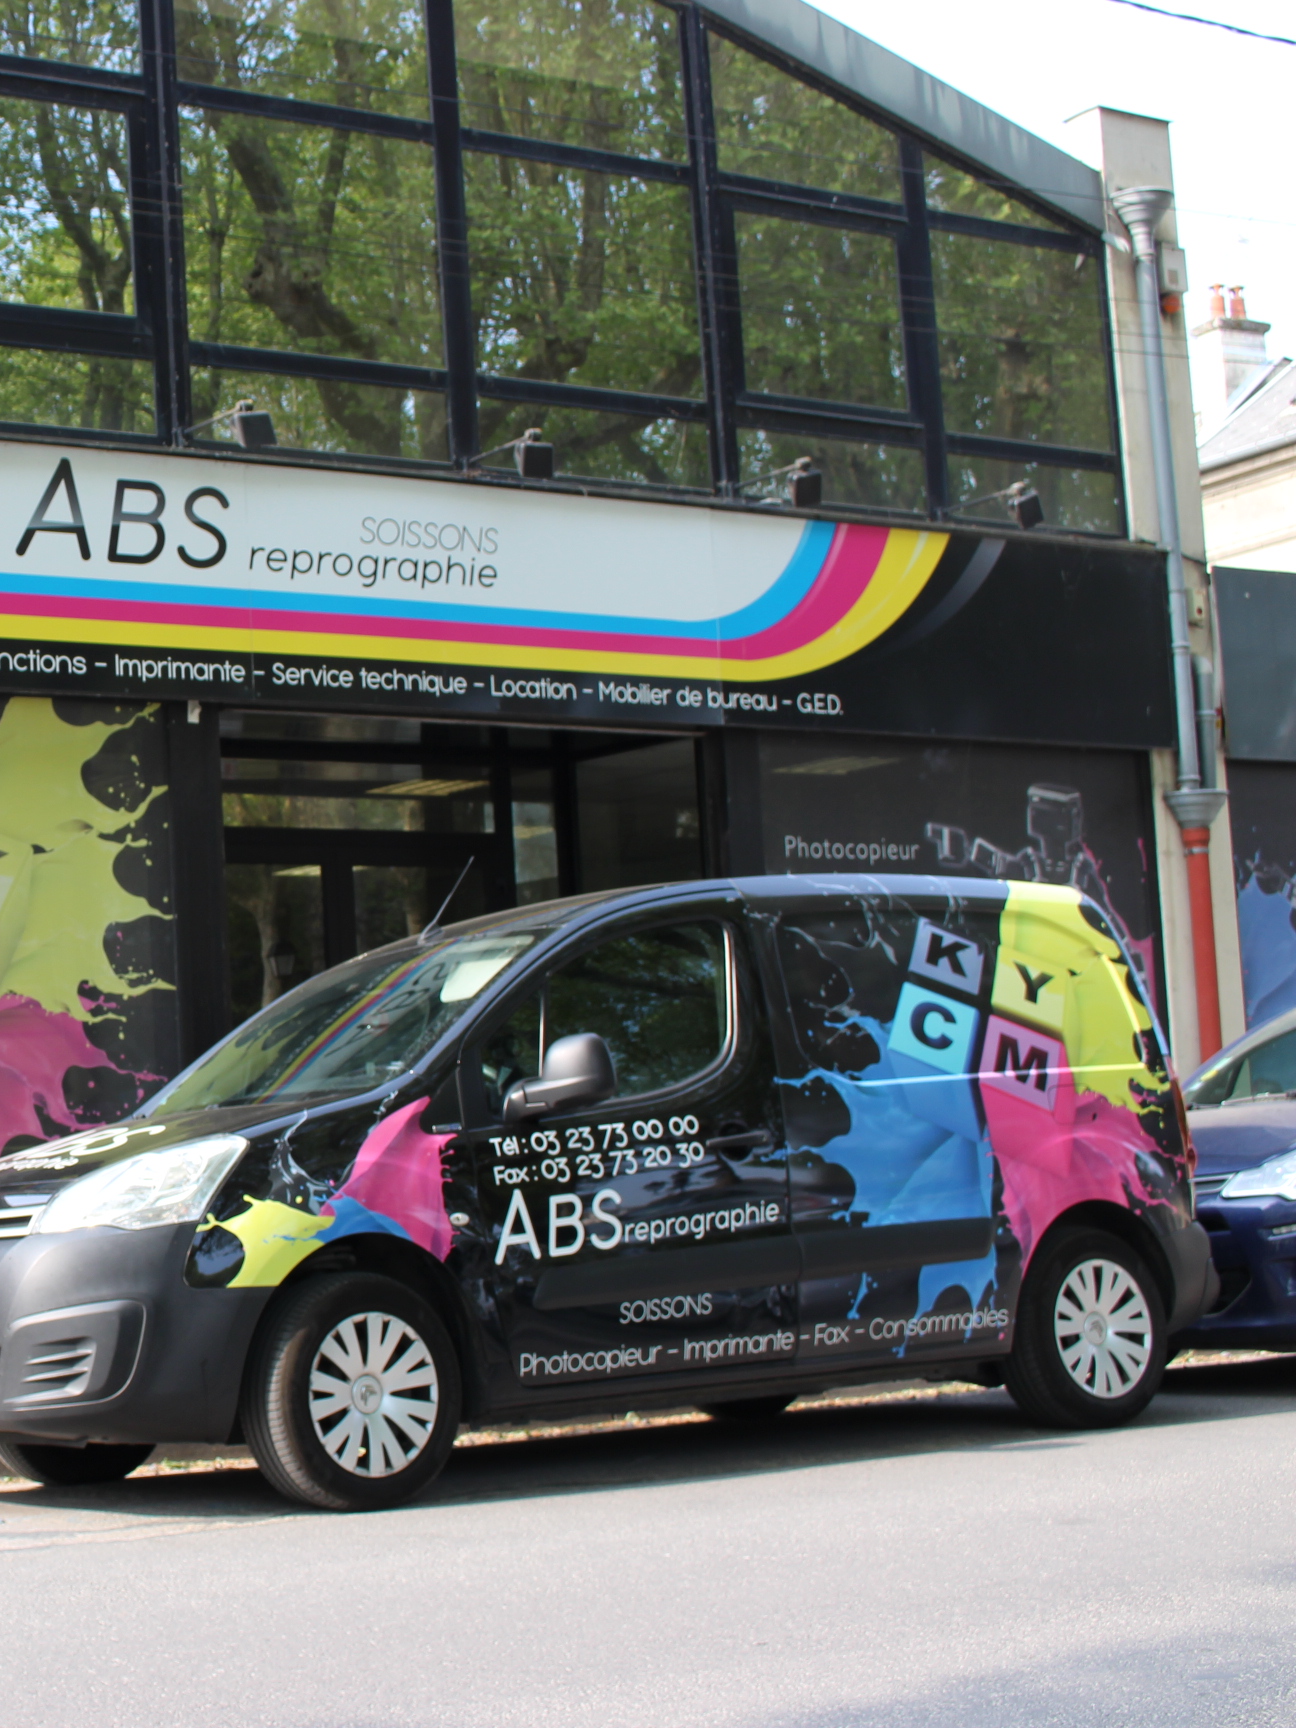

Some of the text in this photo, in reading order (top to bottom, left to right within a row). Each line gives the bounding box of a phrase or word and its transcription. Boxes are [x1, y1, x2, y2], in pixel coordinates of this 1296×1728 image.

[15, 457, 230, 569] ABS
[359, 516, 500, 554] SOISSONS
[248, 545, 499, 590] reprographie
[115, 653, 246, 683] Imprimante
[271, 662, 354, 688] Service
[359, 666, 467, 697] technique
[490, 674, 577, 701] Location
[598, 681, 672, 706] Mobilier
[675, 685, 703, 708] de
[707, 688, 777, 711] bureau
[784, 834, 921, 866] Photocopieur
[925, 933, 1054, 1004] K Y
[908, 1002, 1050, 1094] C M
[530, 1131, 561, 1156] 03
[566, 1126, 595, 1152] 23
[598, 1122, 629, 1150] 73
[632, 1118, 664, 1141] 00
[668, 1114, 700, 1137] 00
[540, 1158, 571, 1183] 03
[576, 1153, 604, 1179] 23
[609, 1149, 639, 1177] 73
[643, 1146, 672, 1168] 20
[676, 1142, 705, 1168] 30
[494, 1188, 781, 1266] ABS reprographie
[619, 1293, 713, 1325] SOISSONS
[519, 1344, 663, 1377] Photocopieur
[683, 1329, 795, 1363] Imprimante
[813, 1322, 850, 1347] Fax
[868, 1306, 1010, 1341] Consommables
